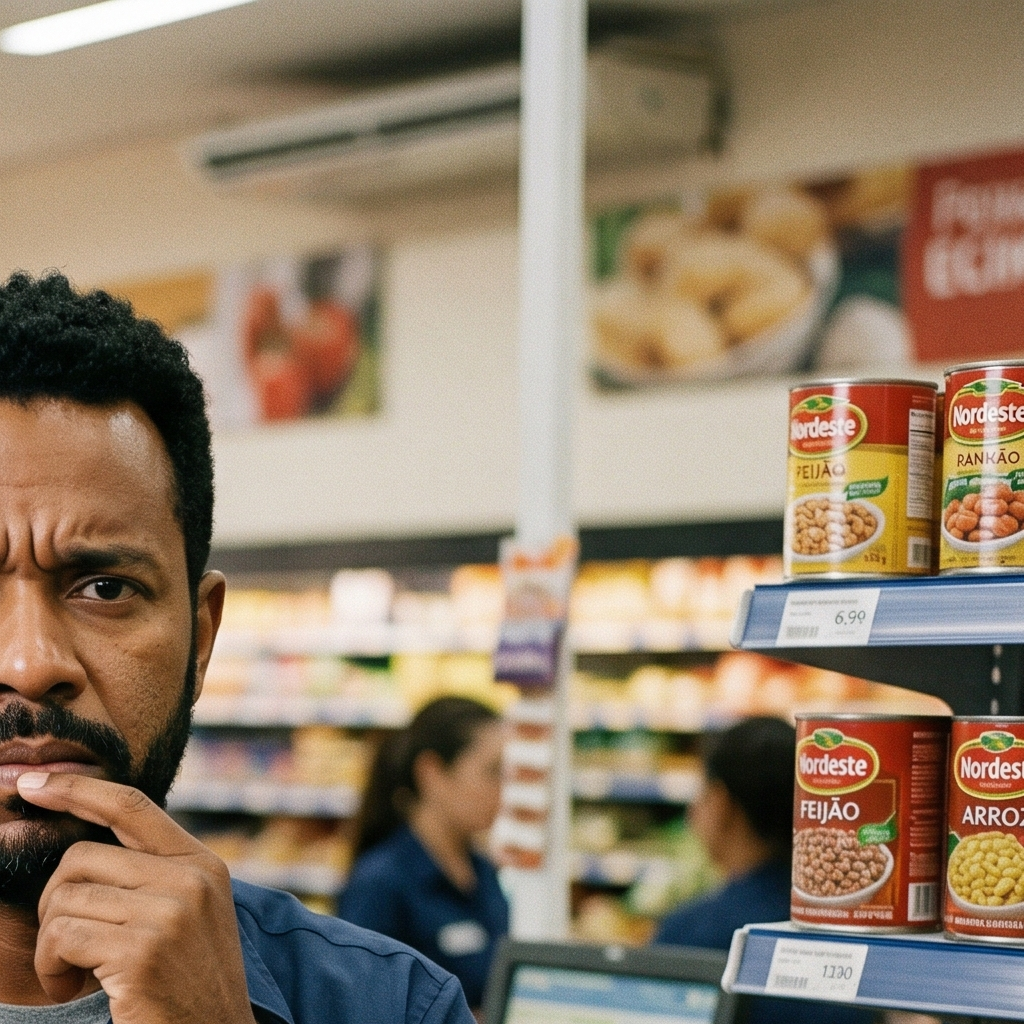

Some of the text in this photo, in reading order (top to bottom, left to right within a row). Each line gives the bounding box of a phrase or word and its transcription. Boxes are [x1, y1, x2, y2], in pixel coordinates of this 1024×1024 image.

[953, 401, 1024, 428] Nordeste
[799, 752, 868, 776] Nordeste
[960, 756, 1024, 780] Nordes
[800, 797, 860, 824] FEIJÃO
